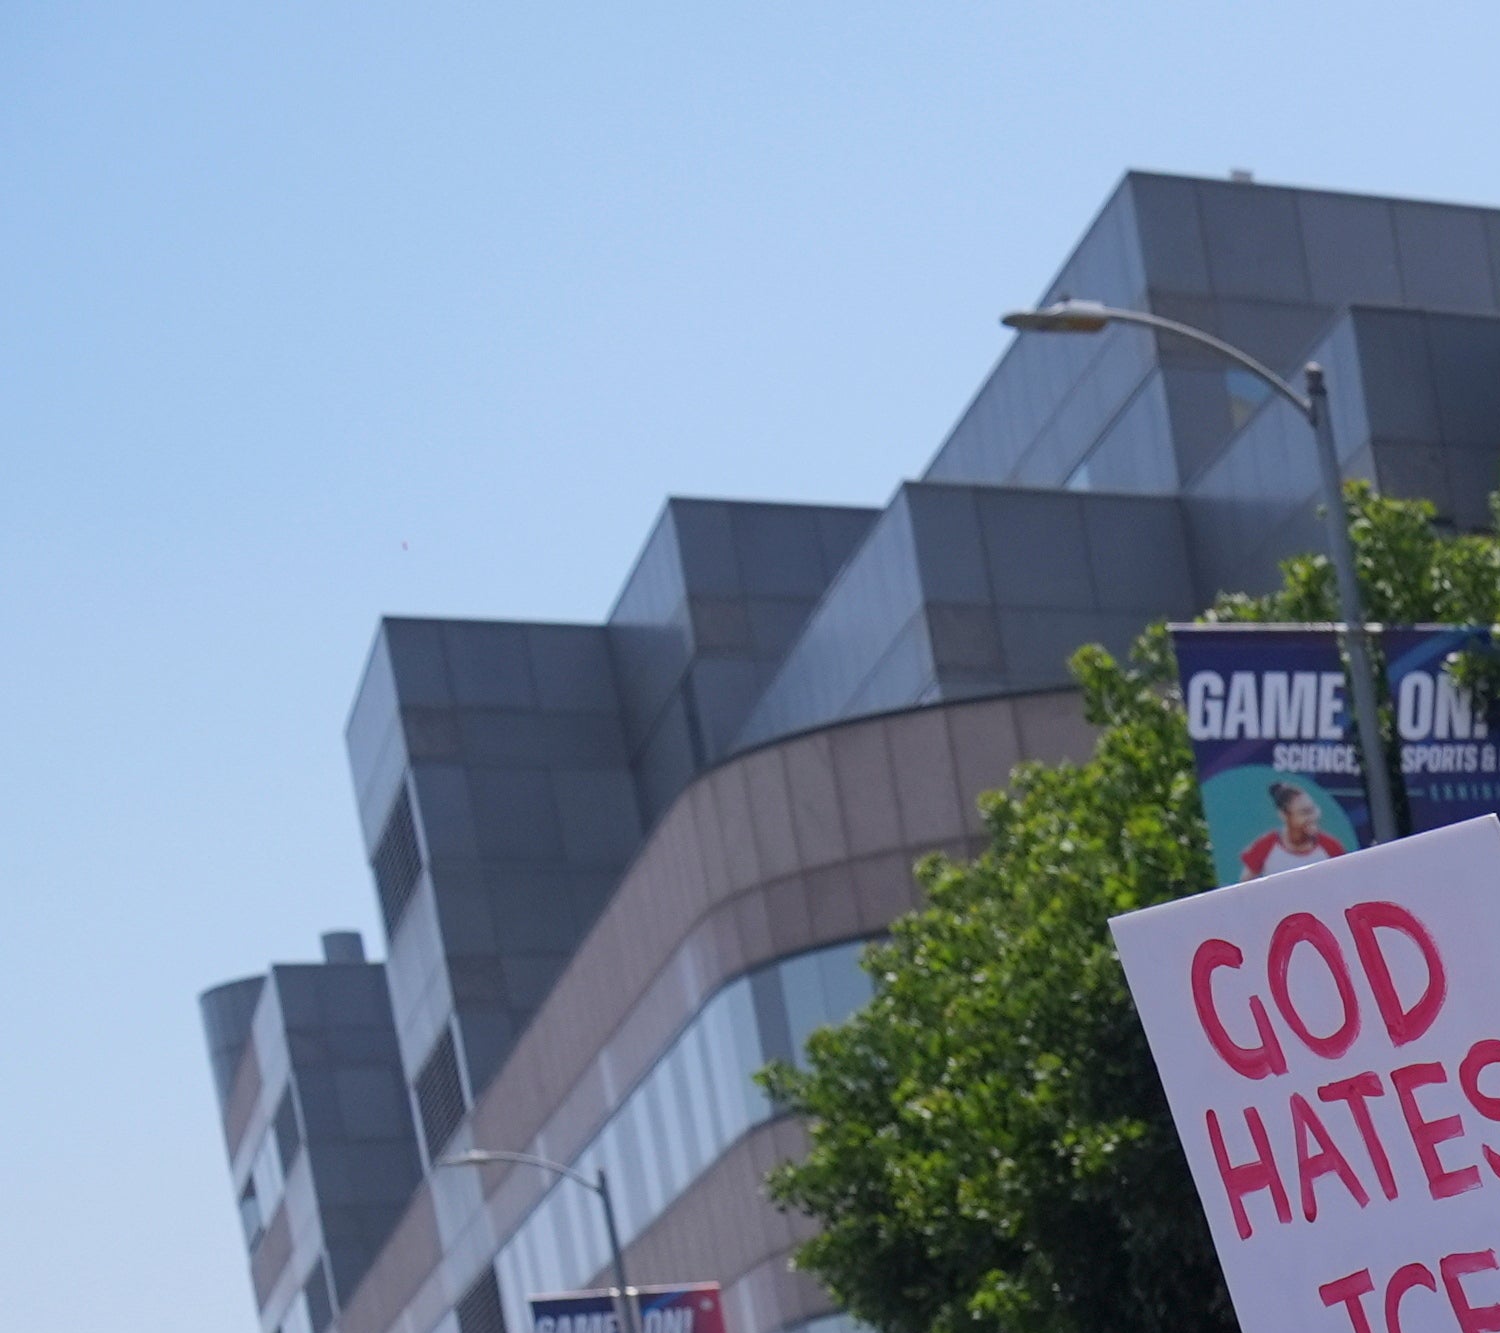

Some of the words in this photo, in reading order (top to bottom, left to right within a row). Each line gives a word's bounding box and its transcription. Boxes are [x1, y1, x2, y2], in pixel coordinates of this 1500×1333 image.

[1188, 671, 1344, 741] GAME
[1273, 745, 1361, 776] SCIENCE,
[1401, 744, 1477, 773] SPORTS
[1481, 744, 1497, 771] &
[1190, 899, 1449, 1081] GOD
